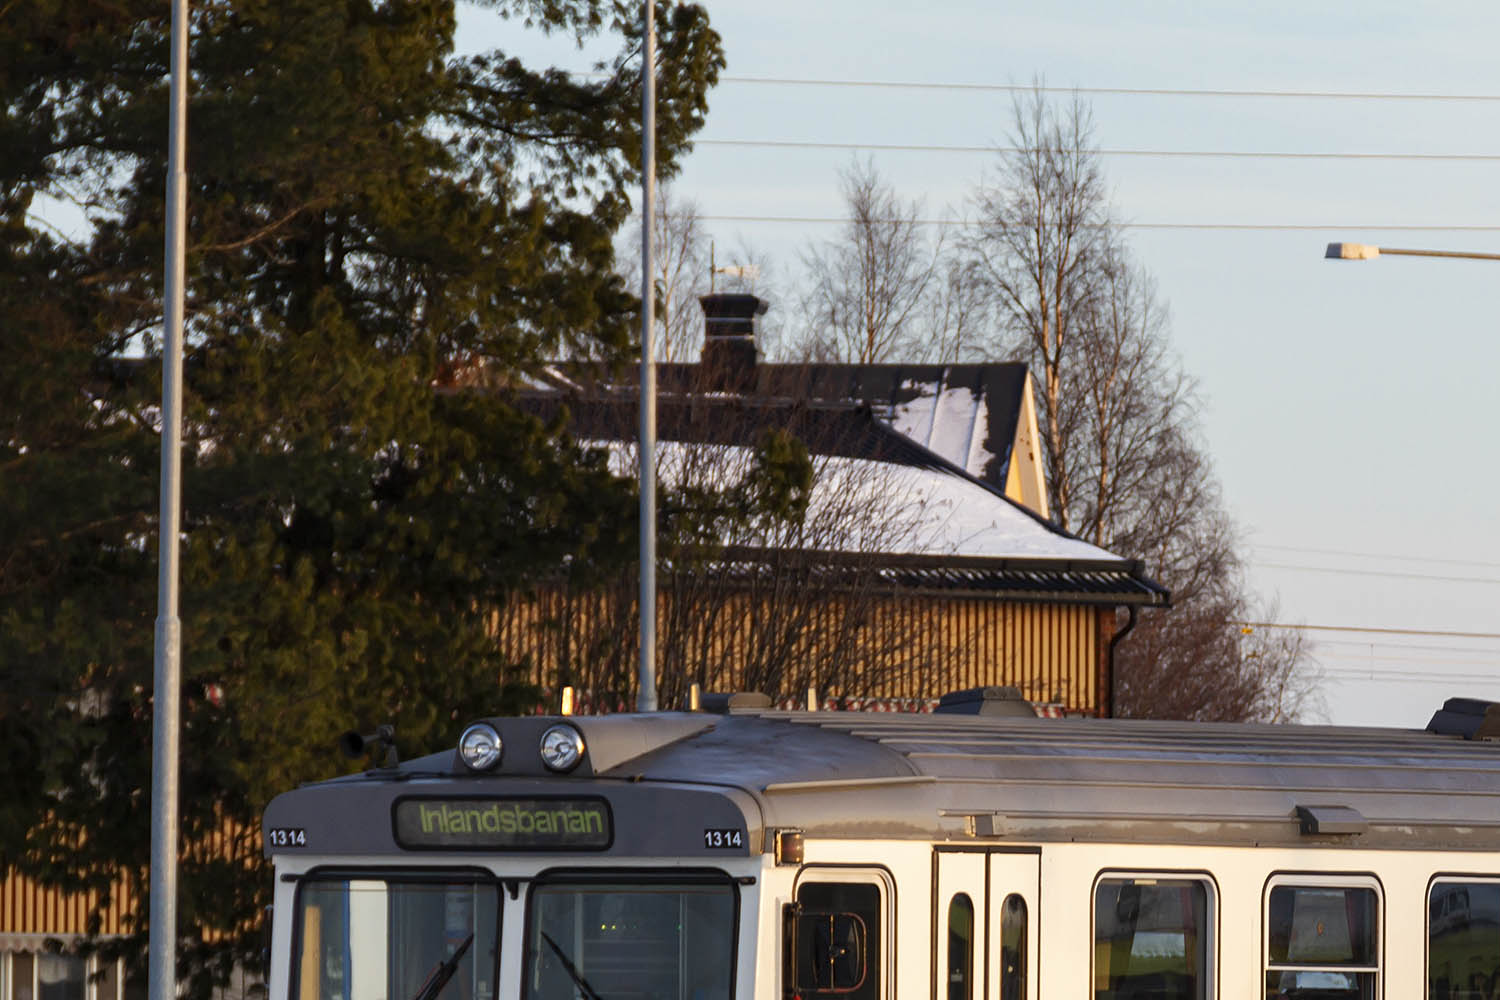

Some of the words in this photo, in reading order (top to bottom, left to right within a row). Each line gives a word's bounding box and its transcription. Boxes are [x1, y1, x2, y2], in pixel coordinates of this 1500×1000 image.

[418, 804, 604, 834] Inlandsbanan
[270, 829, 306, 846] 1314
[704, 831, 742, 847] 1314
